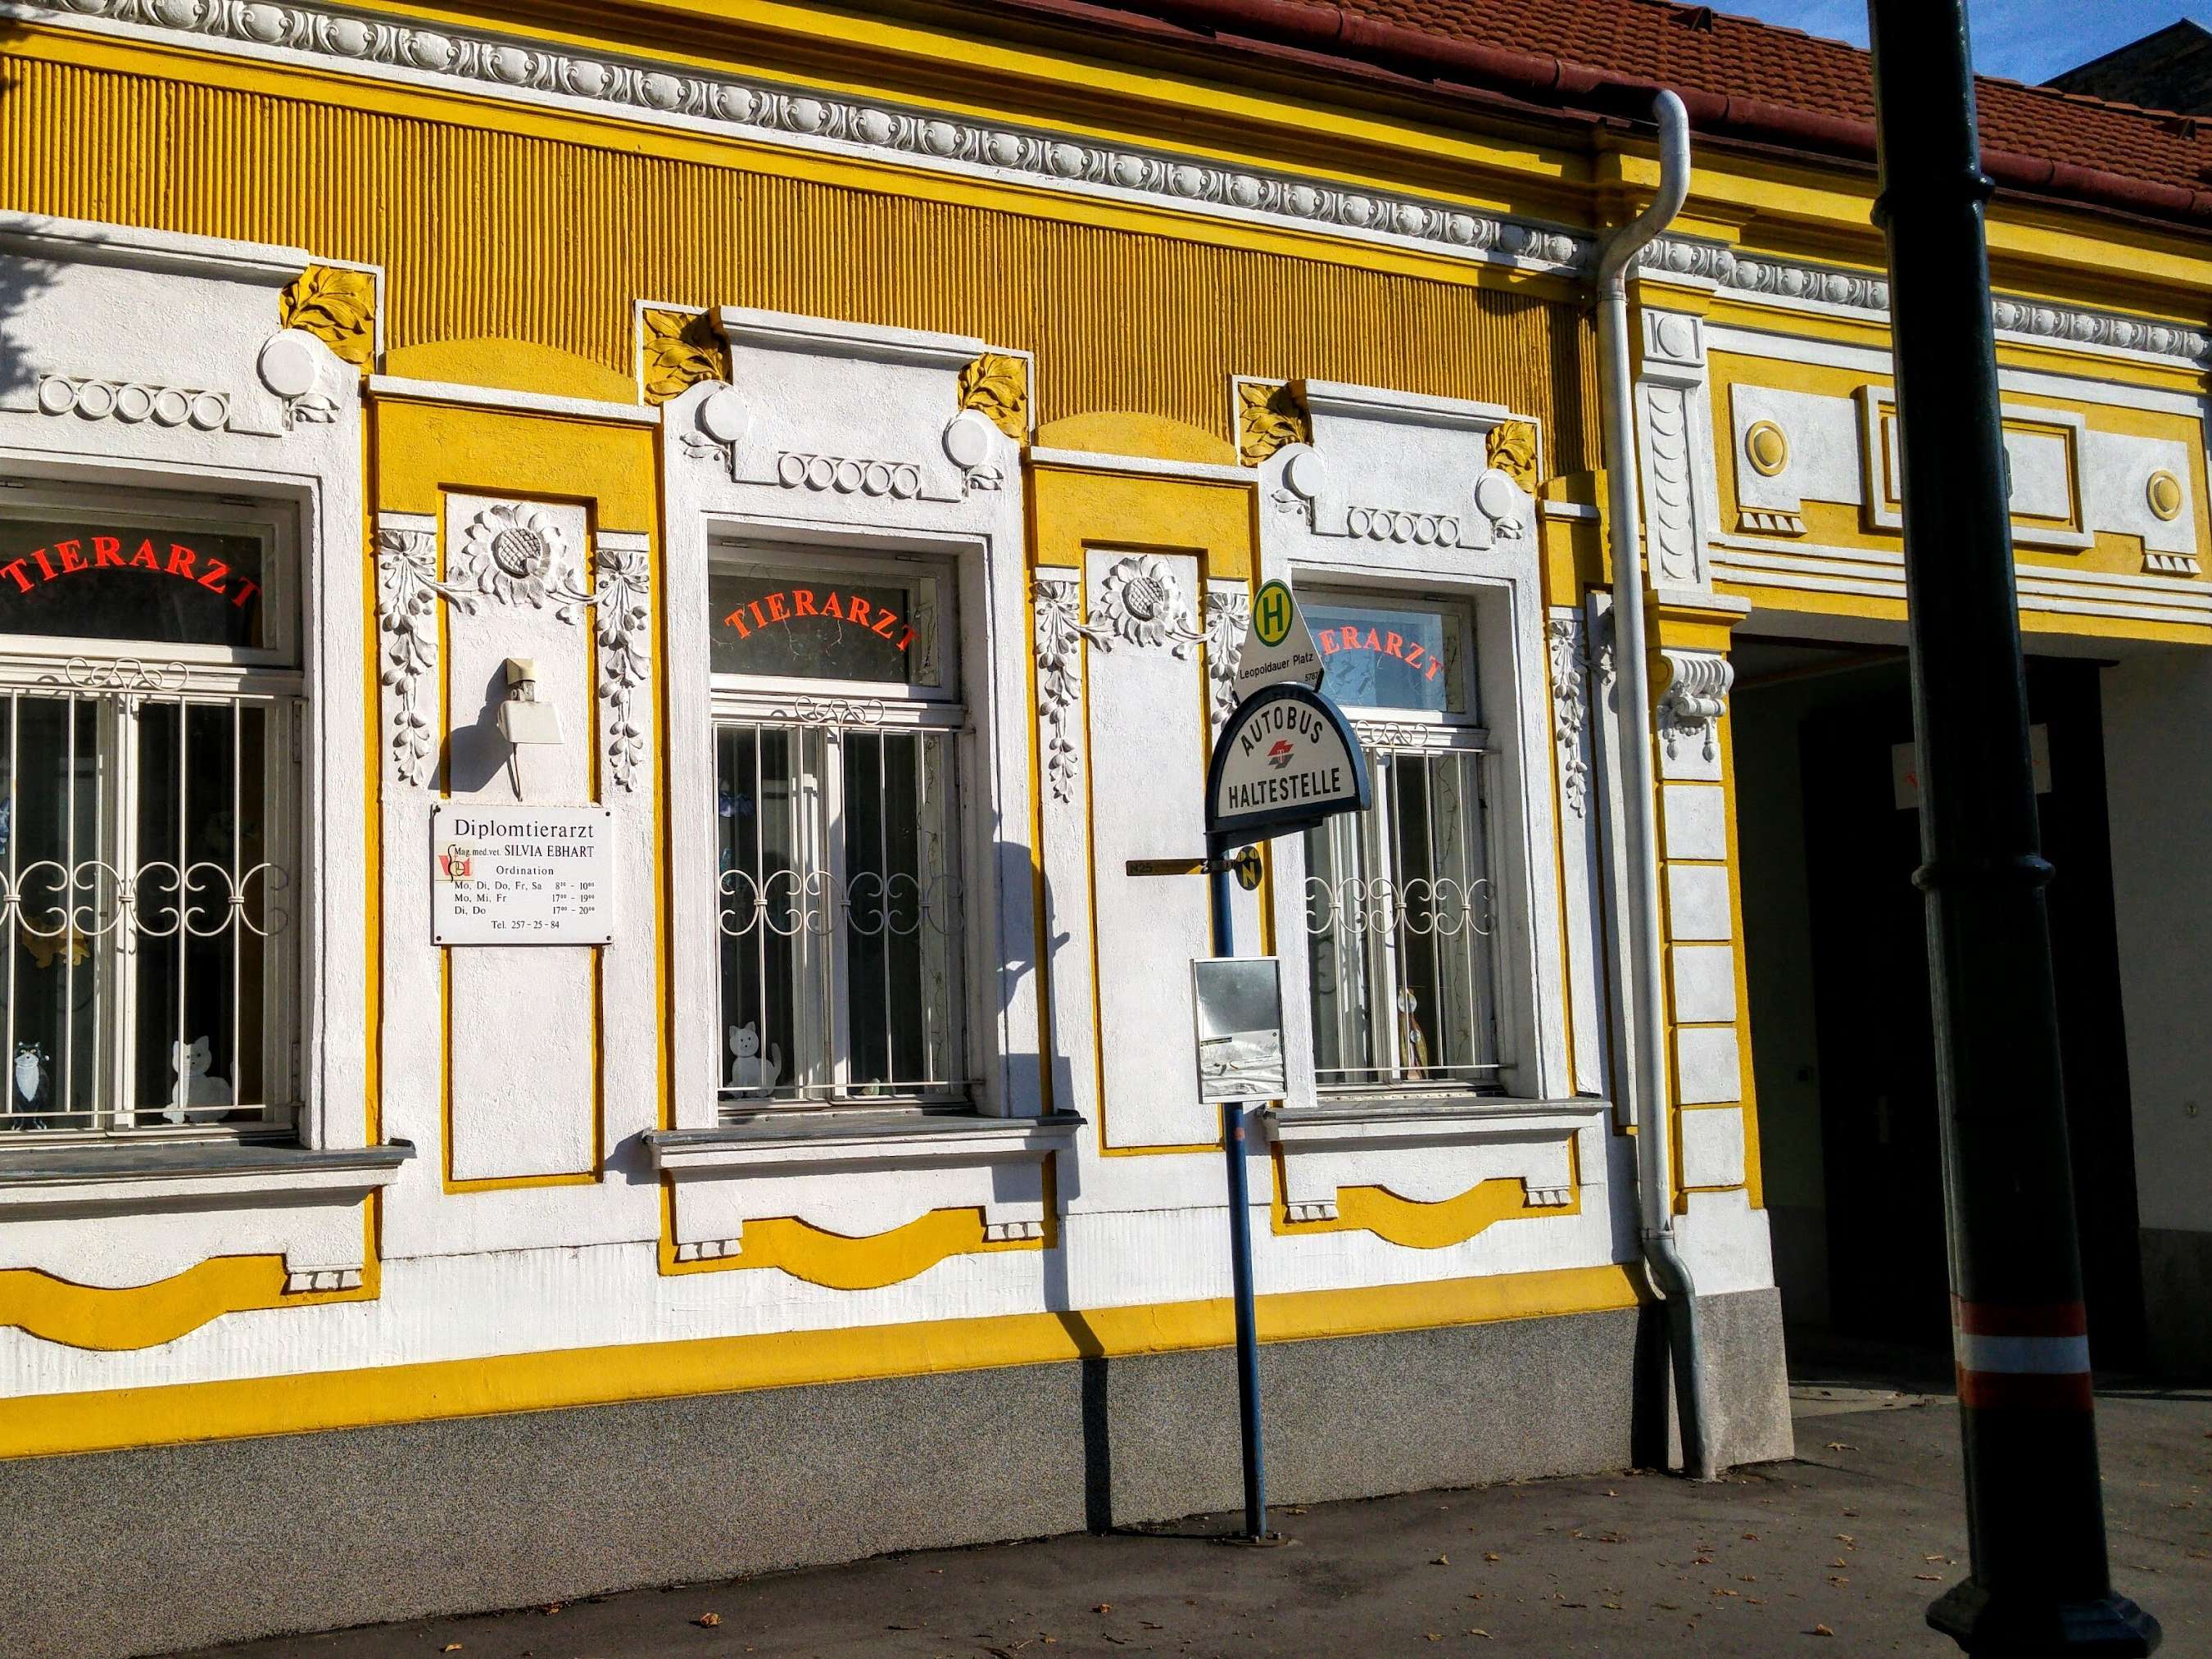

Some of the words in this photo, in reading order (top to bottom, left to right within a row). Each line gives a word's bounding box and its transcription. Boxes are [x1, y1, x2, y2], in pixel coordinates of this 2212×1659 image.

[0, 537, 262, 608] TIERARZT
[724, 589, 920, 652] TIERARZT
[1262, 593, 1284, 636] H
[1240, 660, 1290, 679] Leopoldauer
[1293, 653, 1314, 666] Platz
[1318, 624, 1444, 682] ERARZT
[1240, 705, 1324, 756] AUTOBUS
[1228, 768, 1341, 809] HALTESTELLE
[455, 819, 595, 840] Diplomtierarzt
[505, 845, 542, 857] SILVIA
[547, 845, 595, 858] EBHART
[496, 865, 554, 875] Ordination
[1242, 861, 1256, 887] N
[455, 881, 472, 891] Mo,
[477, 881, 490, 891] Di,
[495, 881, 510, 891] Do,
[515, 881, 528, 891] Fr,
[532, 882, 542, 890] Sa
[455, 894, 472, 903] Mo,
[477, 894, 492, 903] Mi,
[496, 894, 506, 902] Fr
[455, 906, 468, 915] Di,
[473, 906, 486, 914] Do
[492, 920, 506, 929] Tel.
